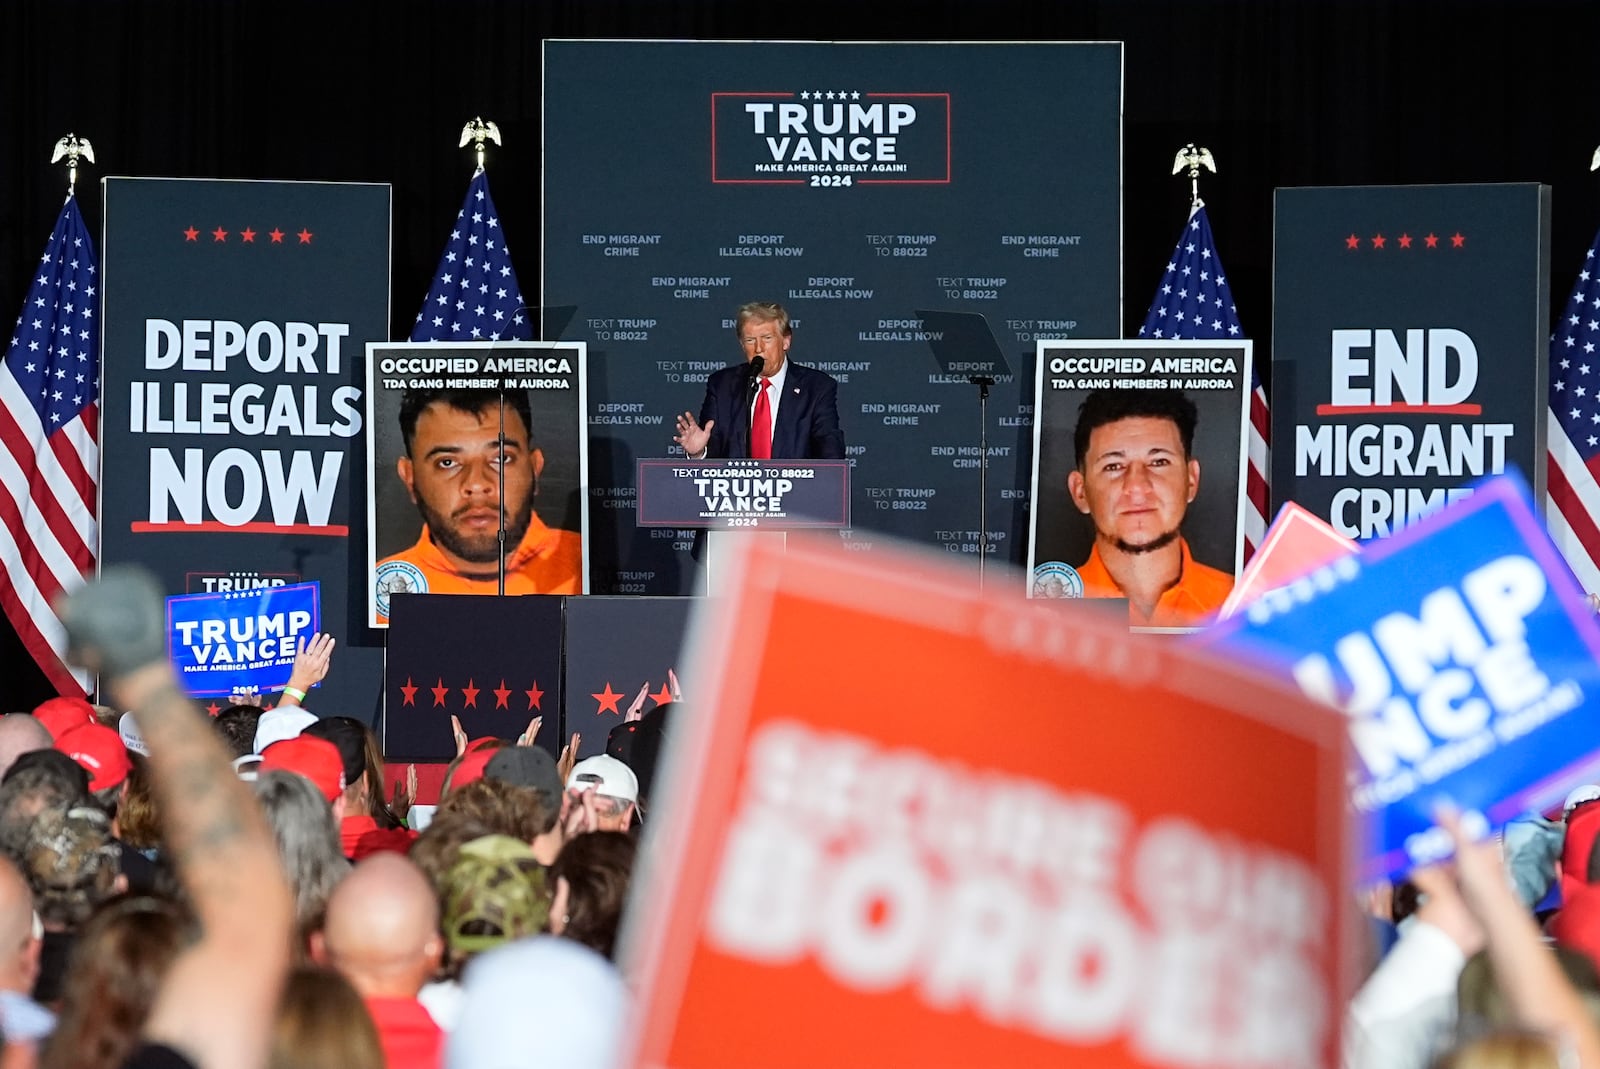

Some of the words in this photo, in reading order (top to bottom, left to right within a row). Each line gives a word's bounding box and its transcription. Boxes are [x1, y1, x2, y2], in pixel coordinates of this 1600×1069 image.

[745, 103, 917, 135] TRUMP
[766, 138, 898, 162] VANCE
[755, 164, 784, 172] MAKE
[786, 164, 833, 172] AMERICA
[835, 164, 869, 172] GREAT
[871, 164, 908, 172] AGAIN!
[810, 175, 852, 187] 2024
[582, 235, 606, 244] END
[608, 235, 662, 244] MIGRANT
[738, 235, 784, 244] DEPORT
[866, 235, 894, 244] TEXT
[896, 235, 937, 244] TRUMP
[1001, 236, 1026, 245] END
[1028, 236, 1081, 245] MIGRANT
[603, 247, 640, 257] CRIME
[719, 247, 773, 257] ILLEGALS
[774, 247, 804, 257] NOW
[875, 247, 890, 257] TO
[892, 247, 928, 257] 88022
[1023, 248, 1060, 257] CRIME
[652, 277, 677, 286] END
[678, 277, 731, 286] MIGRANT
[808, 277, 854, 287] DEPORT
[936, 278, 965, 287] TEXT
[967, 278, 1007, 287] TRUMP
[673, 289, 710, 298] CRIME
[789, 289, 842, 299] ILLEGALS
[844, 289, 874, 299] NOW
[945, 290, 960, 299] TO
[962, 290, 998, 299] 88022
[587, 319, 615, 329] TEXT
[617, 319, 657, 329] TRUMP
[721, 319, 739, 329] EN
[878, 319, 924, 329] DEPORT
[1006, 320, 1035, 330] TEXT
[1037, 320, 1078, 330] TRUMP
[595, 331, 610, 341] TO
[613, 331, 648, 341] 88022
[858, 331, 912, 341] ILLEGALS
[914, 331, 944, 341] NOW
[1015, 332, 1031, 342] TO
[1033, 332, 1068, 341] 88022
[145, 318, 350, 374] DEPORT
[380, 358, 479, 374] OCCUPIED
[483, 358, 572, 374] AMERICA
[656, 361, 685, 371] TEXT
[687, 361, 727, 371] TRUMP
[818, 361, 872, 371] MIGRANT
[948, 362, 995, 371] DEPORT
[1050, 358, 1147, 374] OCCUPIED
[1150, 358, 1237, 374] AMERICA
[1331, 328, 1480, 407] END
[665, 373, 680, 383] TO
[683, 373, 709, 383] 8802
[928, 373, 983, 383] ILLEGA
[985, 373, 1014, 383] OW
[383, 379, 408, 389] TDA
[409, 379, 444, 389] GANG
[504, 379, 518, 389] IN
[519, 379, 570, 389] AURORA
[1051, 379, 1075, 389] TDA
[1077, 379, 1111, 389] GANG
[1113, 379, 1168, 389] MEMBERS
[1170, 379, 1183, 389] IN
[1185, 379, 1234, 389] AURORA
[130, 381, 363, 438] ILLEGALS
[598, 403, 645, 413] DEPORT
[861, 404, 885, 413] END
[888, 404, 941, 413] MIGRANT
[588, 415, 632, 425] LEGALS
[634, 415, 663, 425] NOW
[883, 416, 919, 426] CRIME
[998, 417, 1034, 426] ILLEG
[931, 447, 955, 456] END
[1295, 423, 1515, 477] MIGRANT
[672, 468, 700, 478] TEXT
[701, 468, 763, 479] COLORADO
[765, 468, 779, 478] TO
[781, 469, 815, 479] 88022
[149, 447, 345, 527] NOW
[607, 487, 637, 497] MIGR
[694, 479, 793, 497] TRUMP
[865, 488, 893, 497] TEXT
[896, 488, 936, 497] TRUMP
[1001, 490, 1025, 499] END
[705, 497, 781, 512] VANCE
[874, 500, 890, 509] TO
[892, 500, 927, 509] 88022
[1330, 487, 1475, 540] CRIM
[727, 518, 759, 527] 2024
[650, 530, 674, 539] END
[935, 531, 963, 540] TEXT
[965, 531, 1006, 540] TRMP
[672, 541, 694, 551] CRI
[944, 543, 959, 552] TO
[175, 610, 312, 647] TRUMP
[191, 635, 297, 665] VANCE
[184, 665, 208, 673] MAKE
[209, 663, 247, 673] AMERICA
[249, 659, 273, 670] GREAT
[275, 657, 295, 666] AGAI
